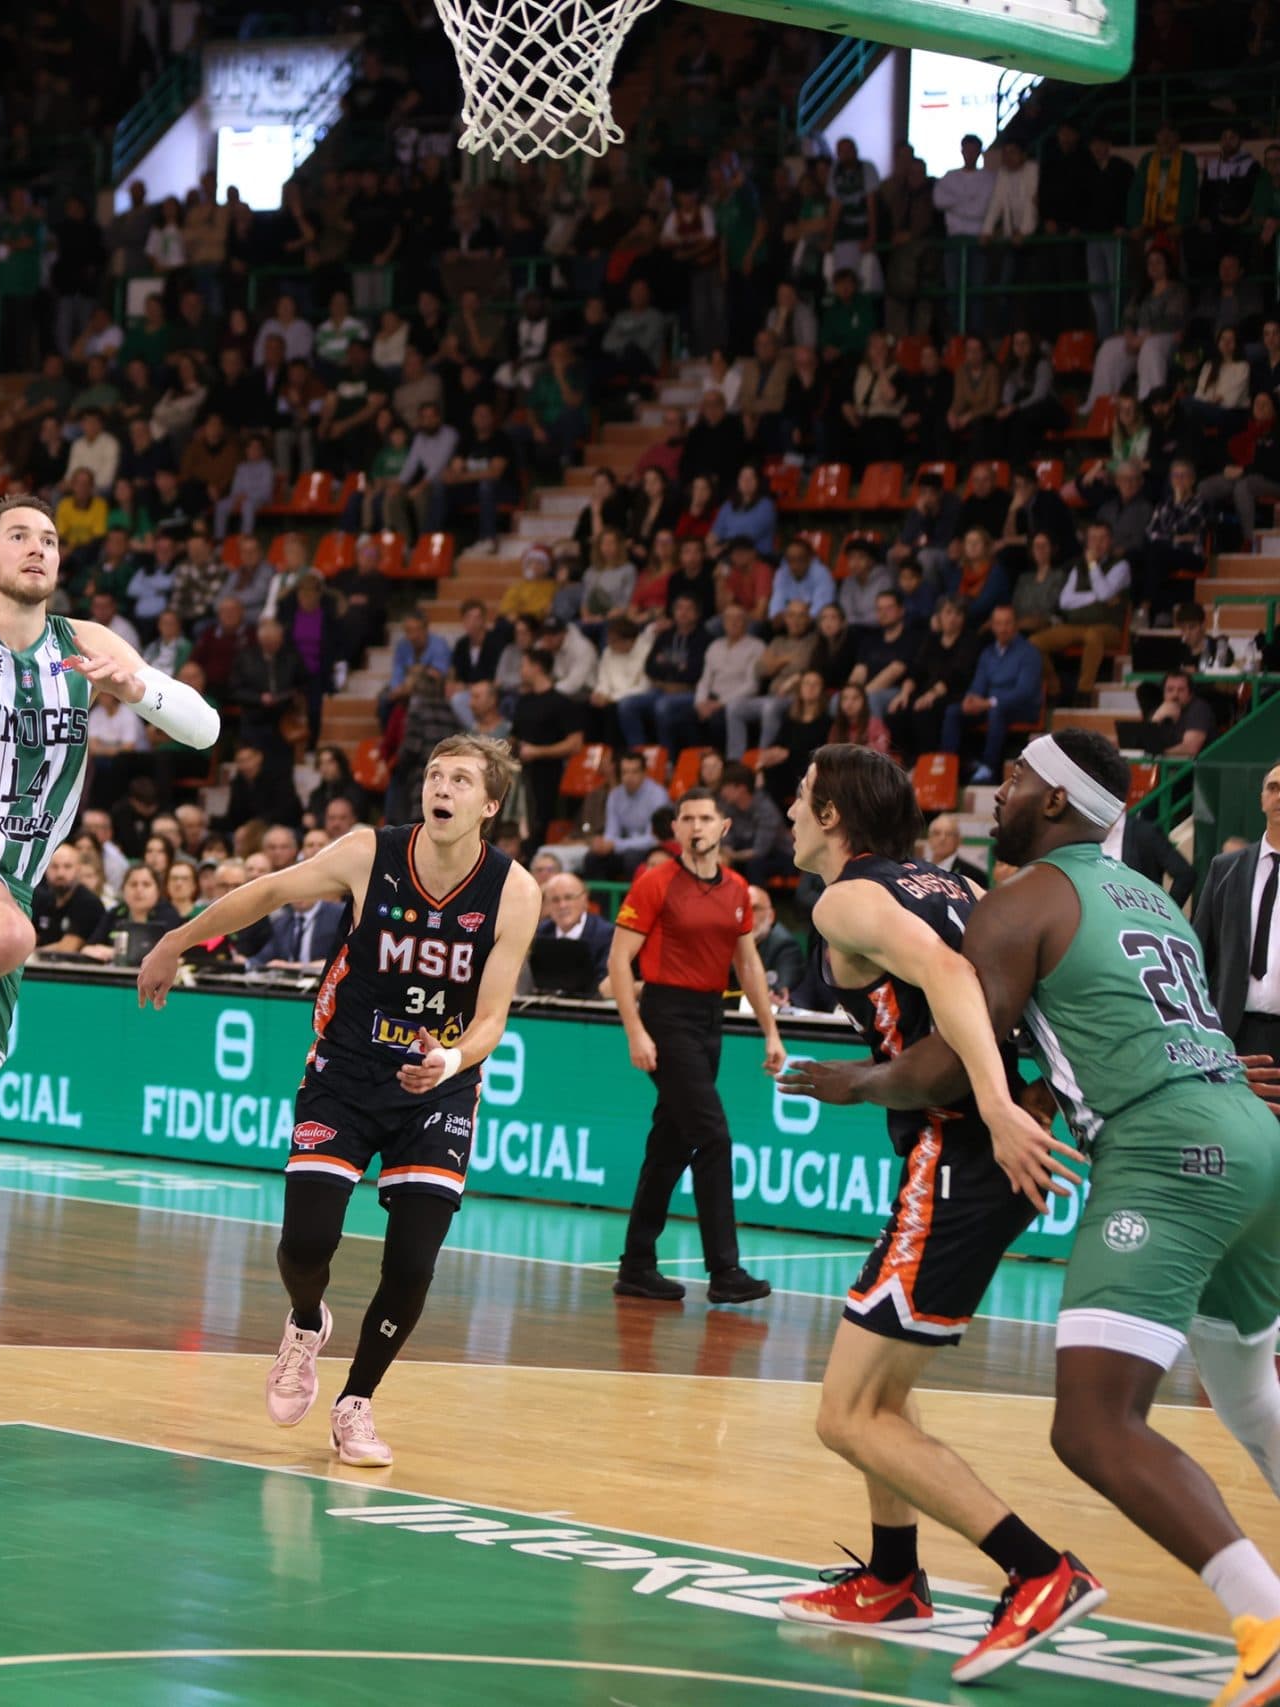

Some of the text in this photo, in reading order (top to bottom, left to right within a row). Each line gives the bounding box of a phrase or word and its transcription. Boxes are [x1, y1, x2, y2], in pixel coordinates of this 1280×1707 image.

[0, 758, 51, 803] 14
[378, 930, 474, 984] MSB
[405, 986, 446, 1016] 34
[1118, 930, 1225, 1036] 20
[142, 1085, 294, 1150] FIDUCIA
[444, 1123, 469, 1138] Rapin
[470, 1118, 605, 1186] UCIAL
[1180, 1144, 1227, 1176] 20
[730, 1142, 894, 1217] DUCIAL
[940, 1164, 952, 1200] 1
[1107, 1217, 1144, 1241] CSP
